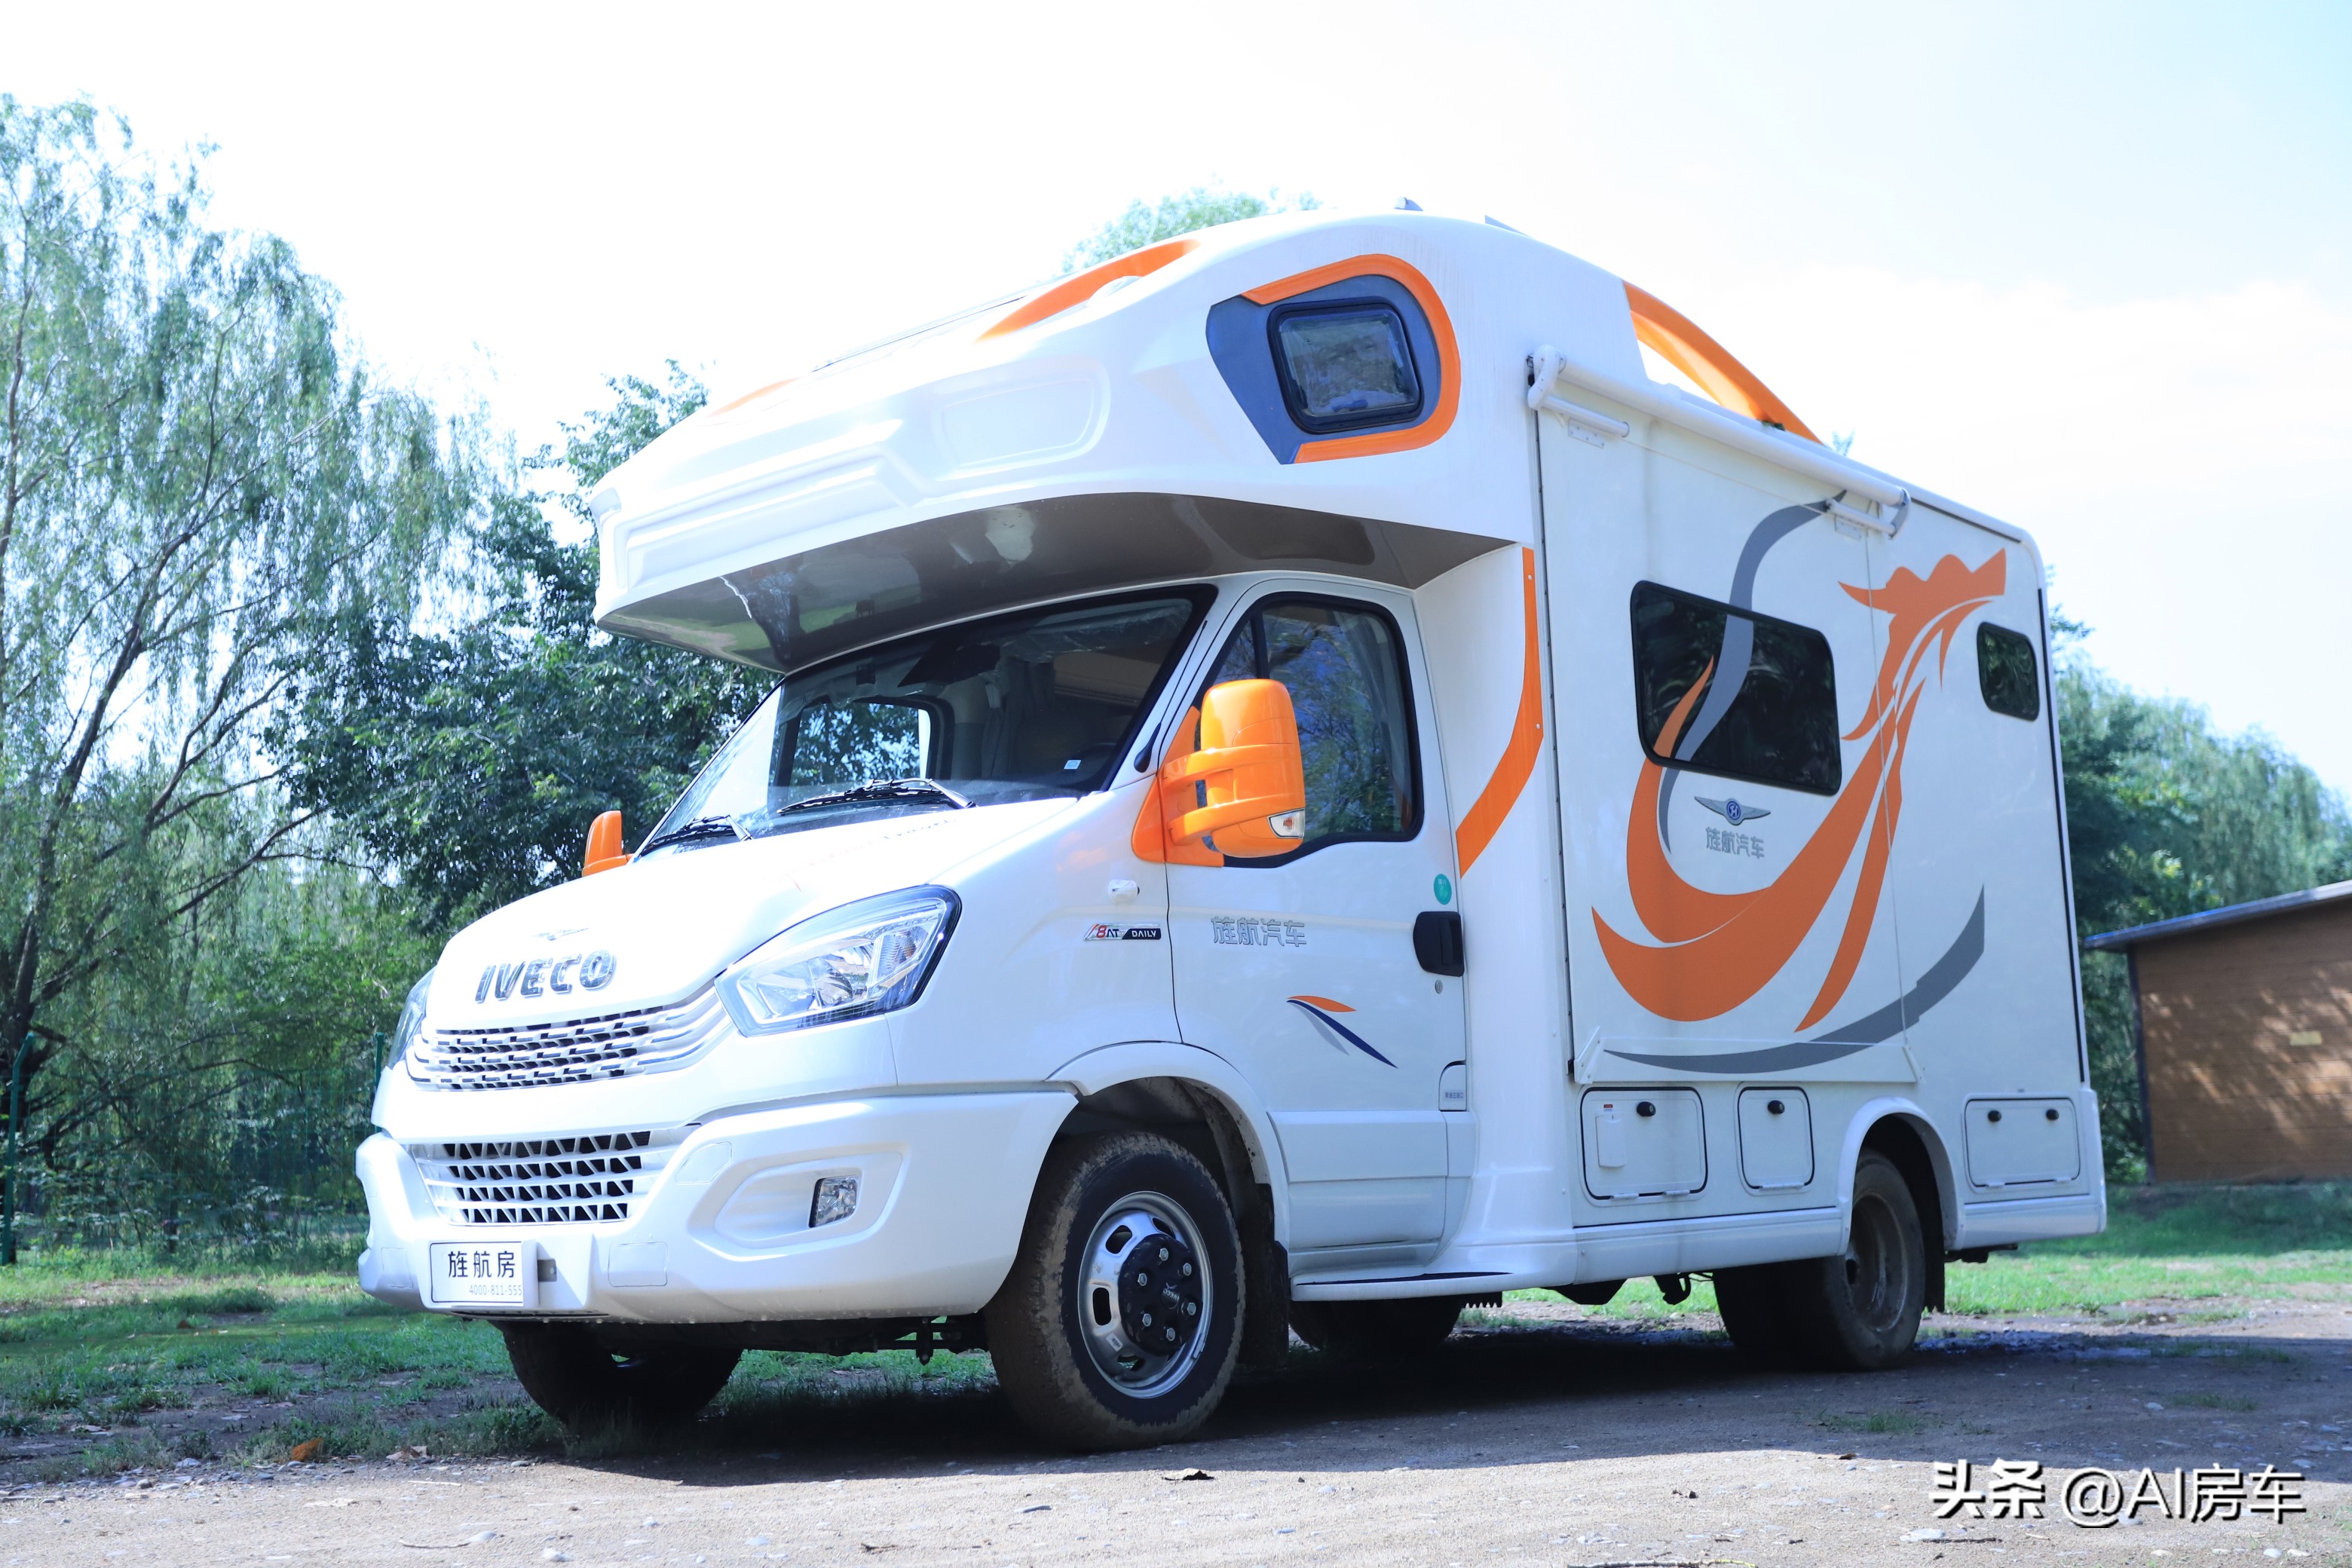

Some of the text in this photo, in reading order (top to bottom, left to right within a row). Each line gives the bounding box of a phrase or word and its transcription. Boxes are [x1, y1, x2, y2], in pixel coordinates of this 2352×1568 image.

[1705, 827, 1765, 859] 旌航汽车
[1210, 917, 1306, 948] 旌航汽车
[474, 950, 617, 1004] IVECO
[447, 1250, 516, 1279] 旌航房
[1162, 1288, 1181, 1301] IVECO
